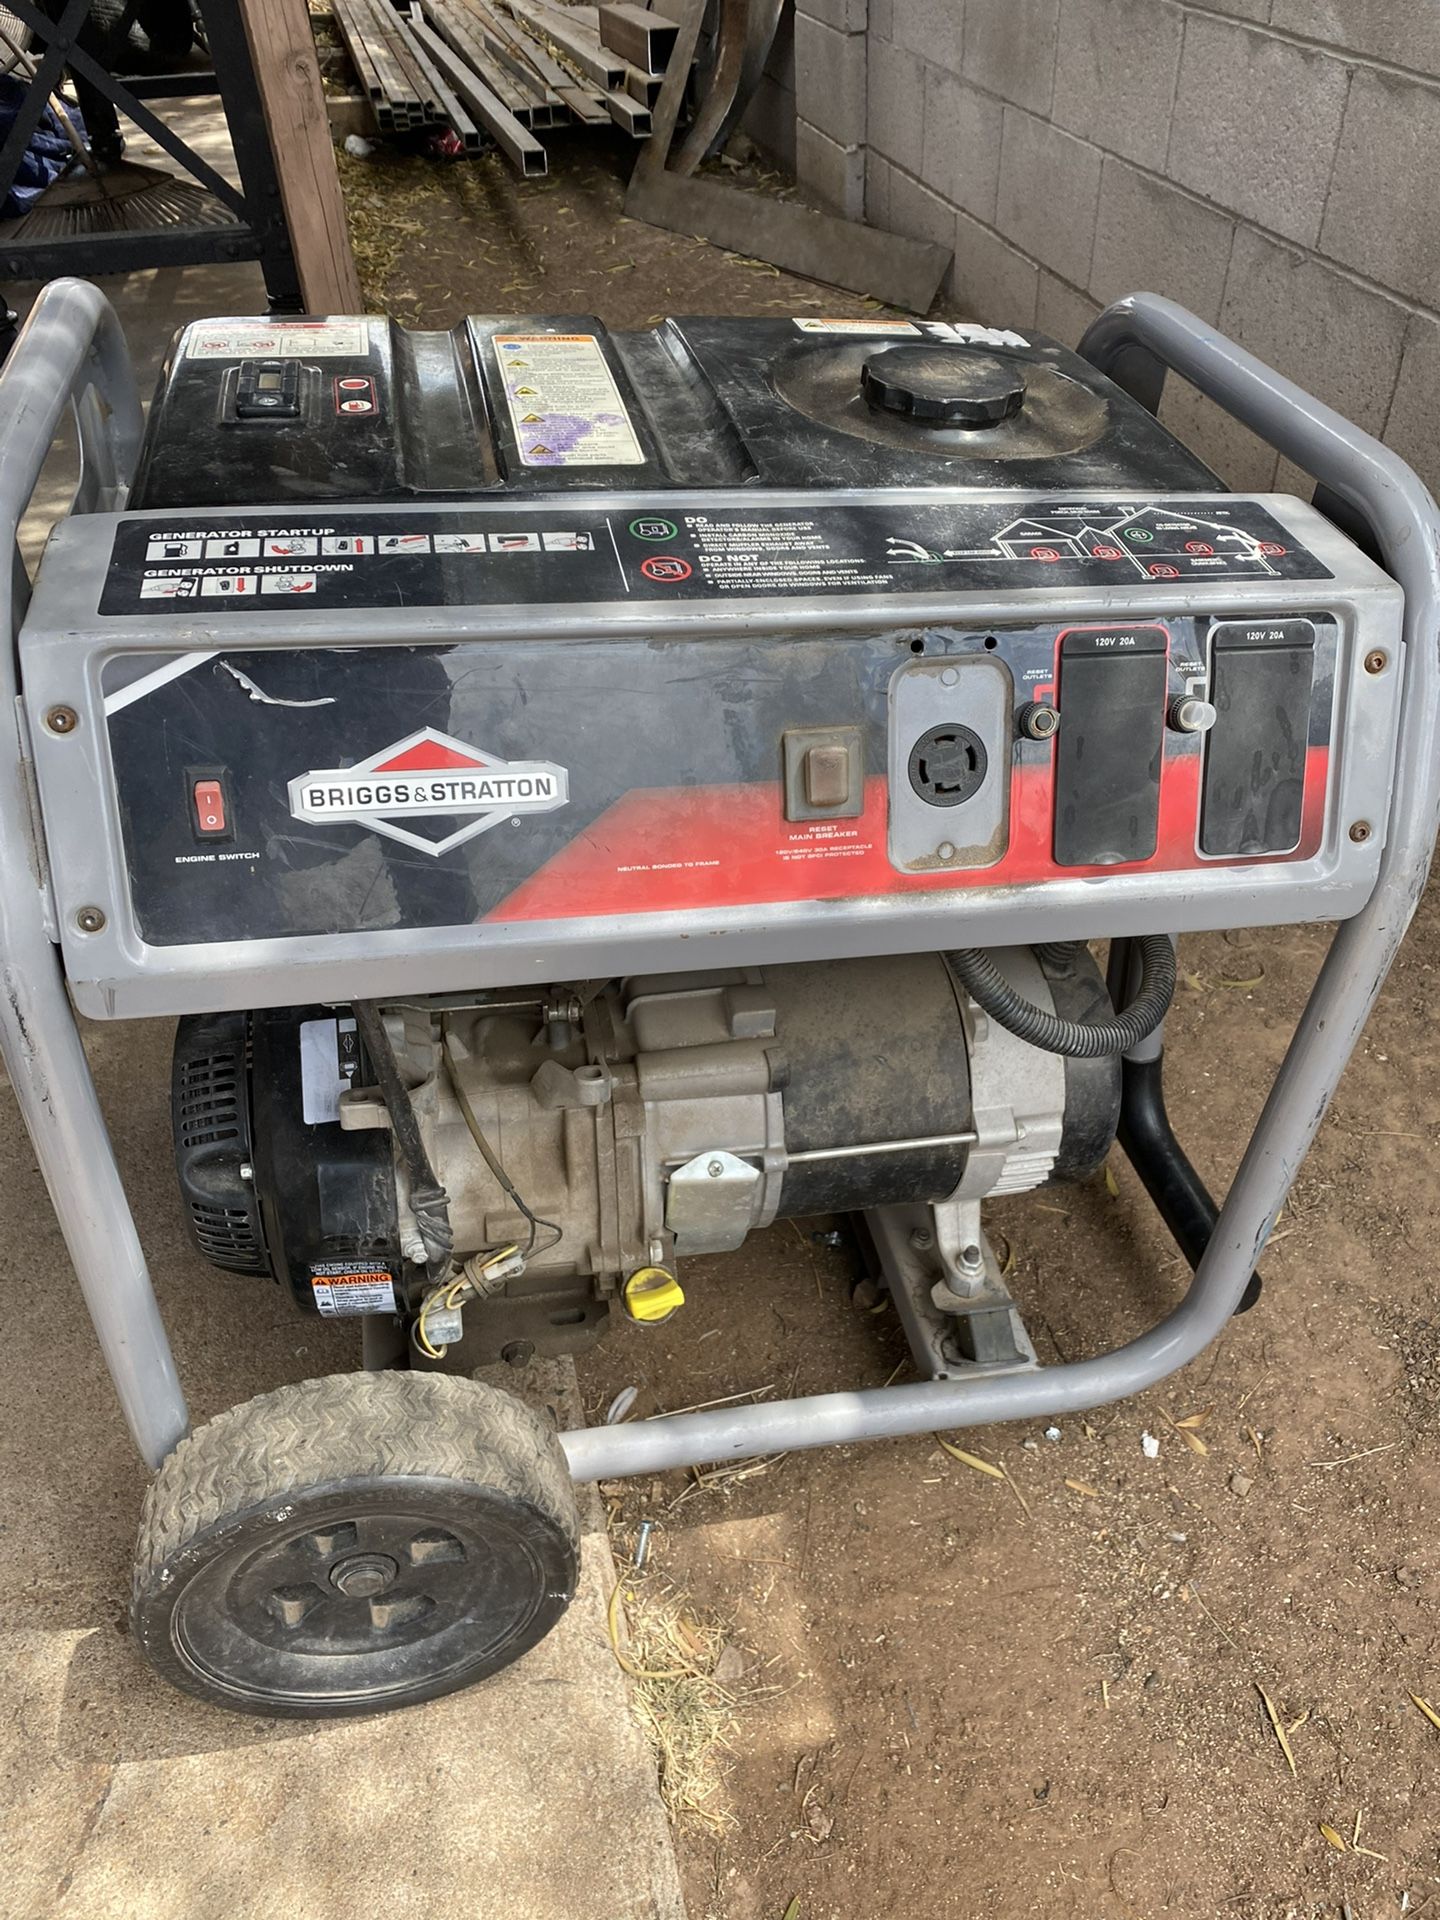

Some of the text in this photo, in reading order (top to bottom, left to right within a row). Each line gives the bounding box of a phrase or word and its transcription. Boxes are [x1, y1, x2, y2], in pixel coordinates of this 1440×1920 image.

[684, 516, 708, 524] DO
[149, 529, 335, 540] GENERATOR STARTUP
[726, 554, 759, 562] NOT
[144, 564, 354, 577] GENERATOR SHUTDOWN
[1246, 631, 1284, 640] 120V 20A
[1095, 636, 1136, 646] 120V 20A
[309, 778, 552, 807] BRIGGS & STRATTON
[809, 825, 838, 833] RESET
[815, 831, 858, 839] BREAKER
[829, 843, 872, 852] RECEPTACLE
[175, 852, 260, 863] ENGINE SWITCH
[824, 850, 865, 858] PROTECTED
[327, 1274, 389, 1285] WARNING
